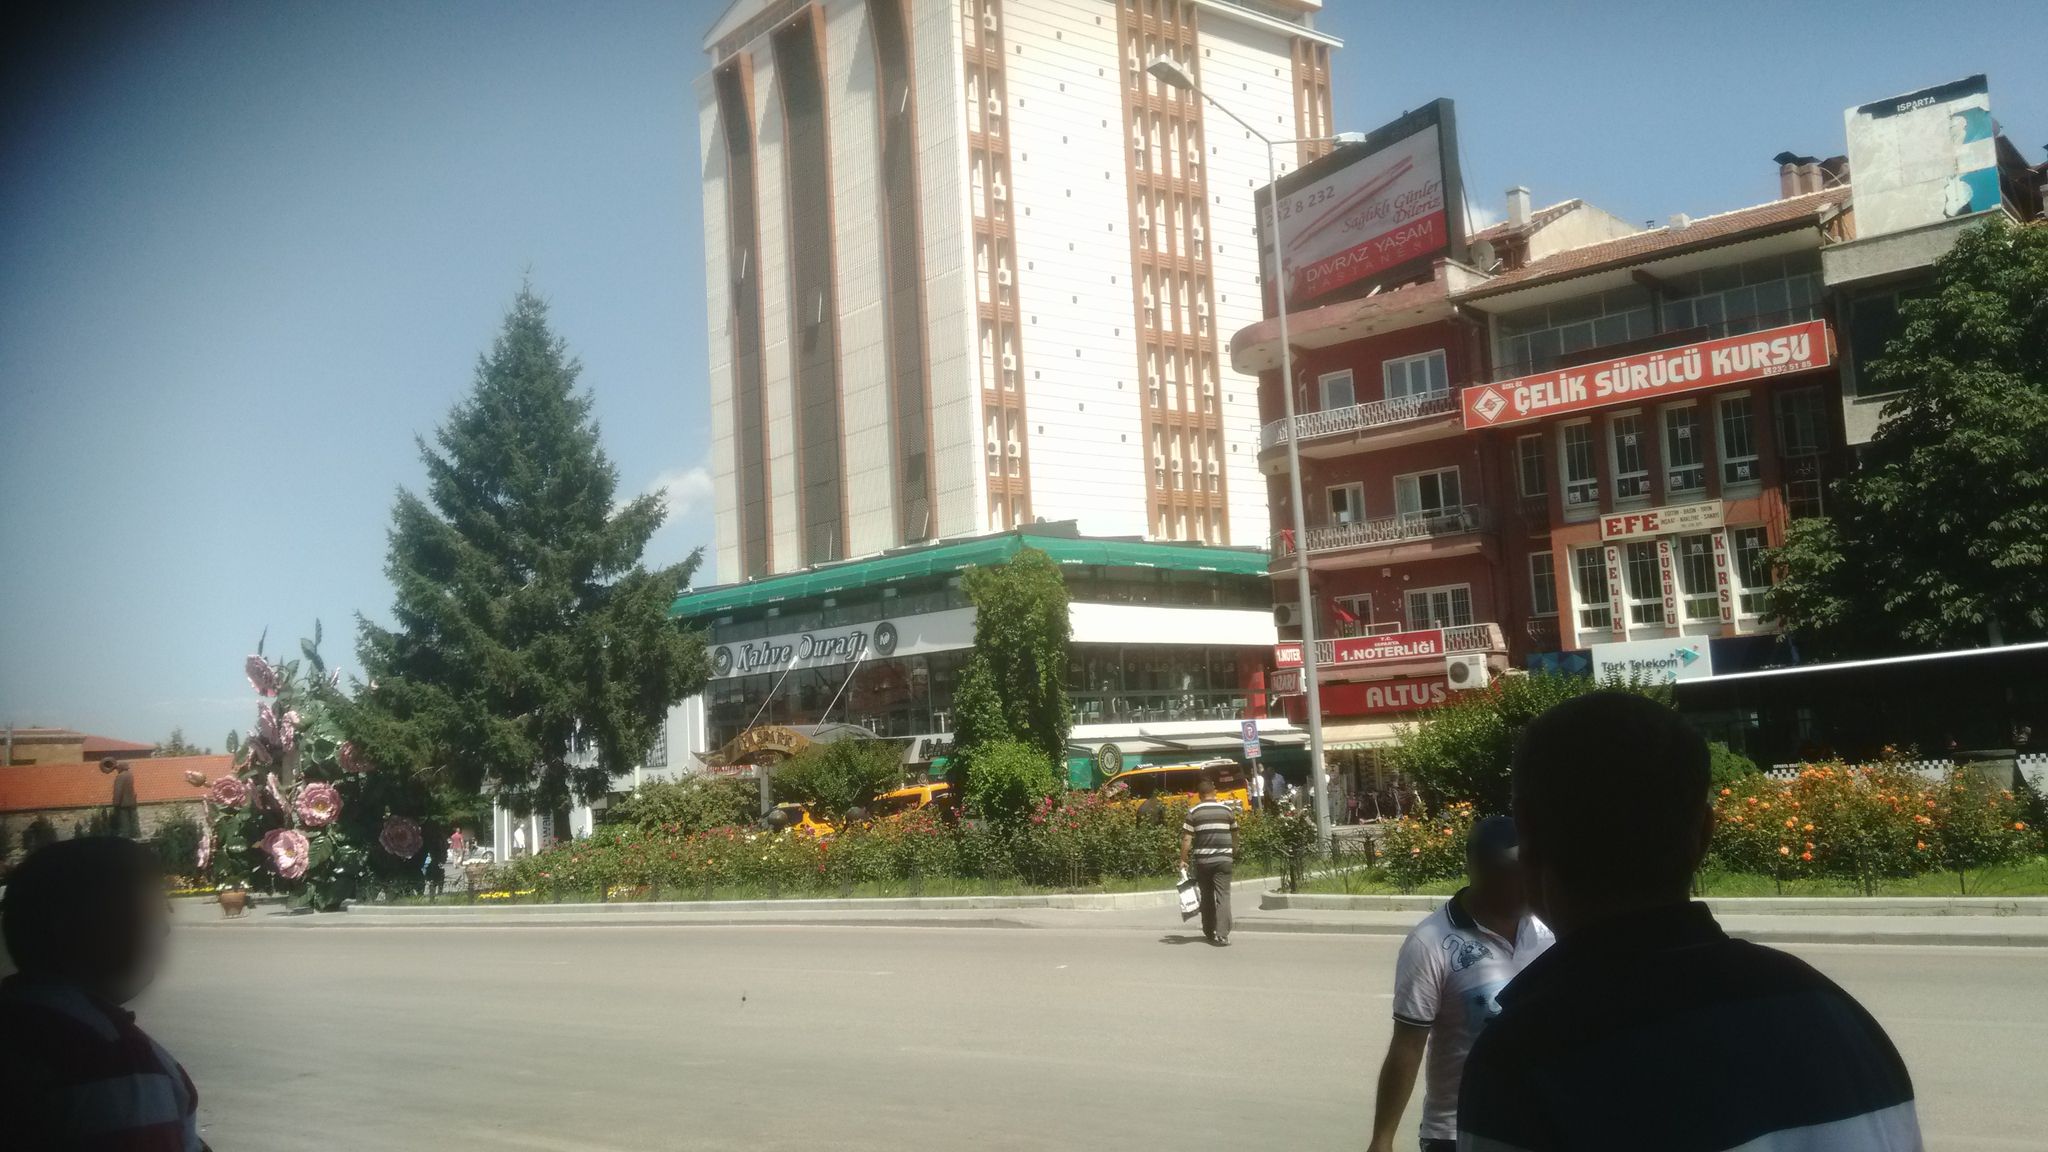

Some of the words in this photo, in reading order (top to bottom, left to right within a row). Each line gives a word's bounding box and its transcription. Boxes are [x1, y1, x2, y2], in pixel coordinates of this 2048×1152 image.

[1896, 96, 1936, 112] ISPARTA
[1295, 202, 1304, 214] 8
[1308, 186, 1336, 209] 232
[1342, 199, 1391, 233] Sağlıklı
[1394, 179, 1442, 209] Günler
[1392, 196, 1442, 225] Dileriz
[1306, 247, 1369, 282] DAVRAZ
[1513, 372, 1588, 416] ÇELİK
[1594, 347, 1702, 398] SÜRÜCÜ
[1711, 332, 1811, 377] KURSU
[1771, 364, 1788, 374] 232
[1788, 363, 1799, 371] 51
[1605, 512, 1660, 537] EFE
[1606, 548, 1623, 631] ÇELİK
[1659, 542, 1676, 625] SÜRÜCÜ
[1713, 535, 1732, 621] KURSU
[736, 640, 793, 673] Kahve
[799, 630, 868, 661] Durağı
[1340, 639, 1435, 662] 1.NOTERLİĞİ
[1601, 661, 1626, 673] Türk
[1629, 657, 1678, 670] Telekom
[1366, 682, 1447, 708] ALTUS
